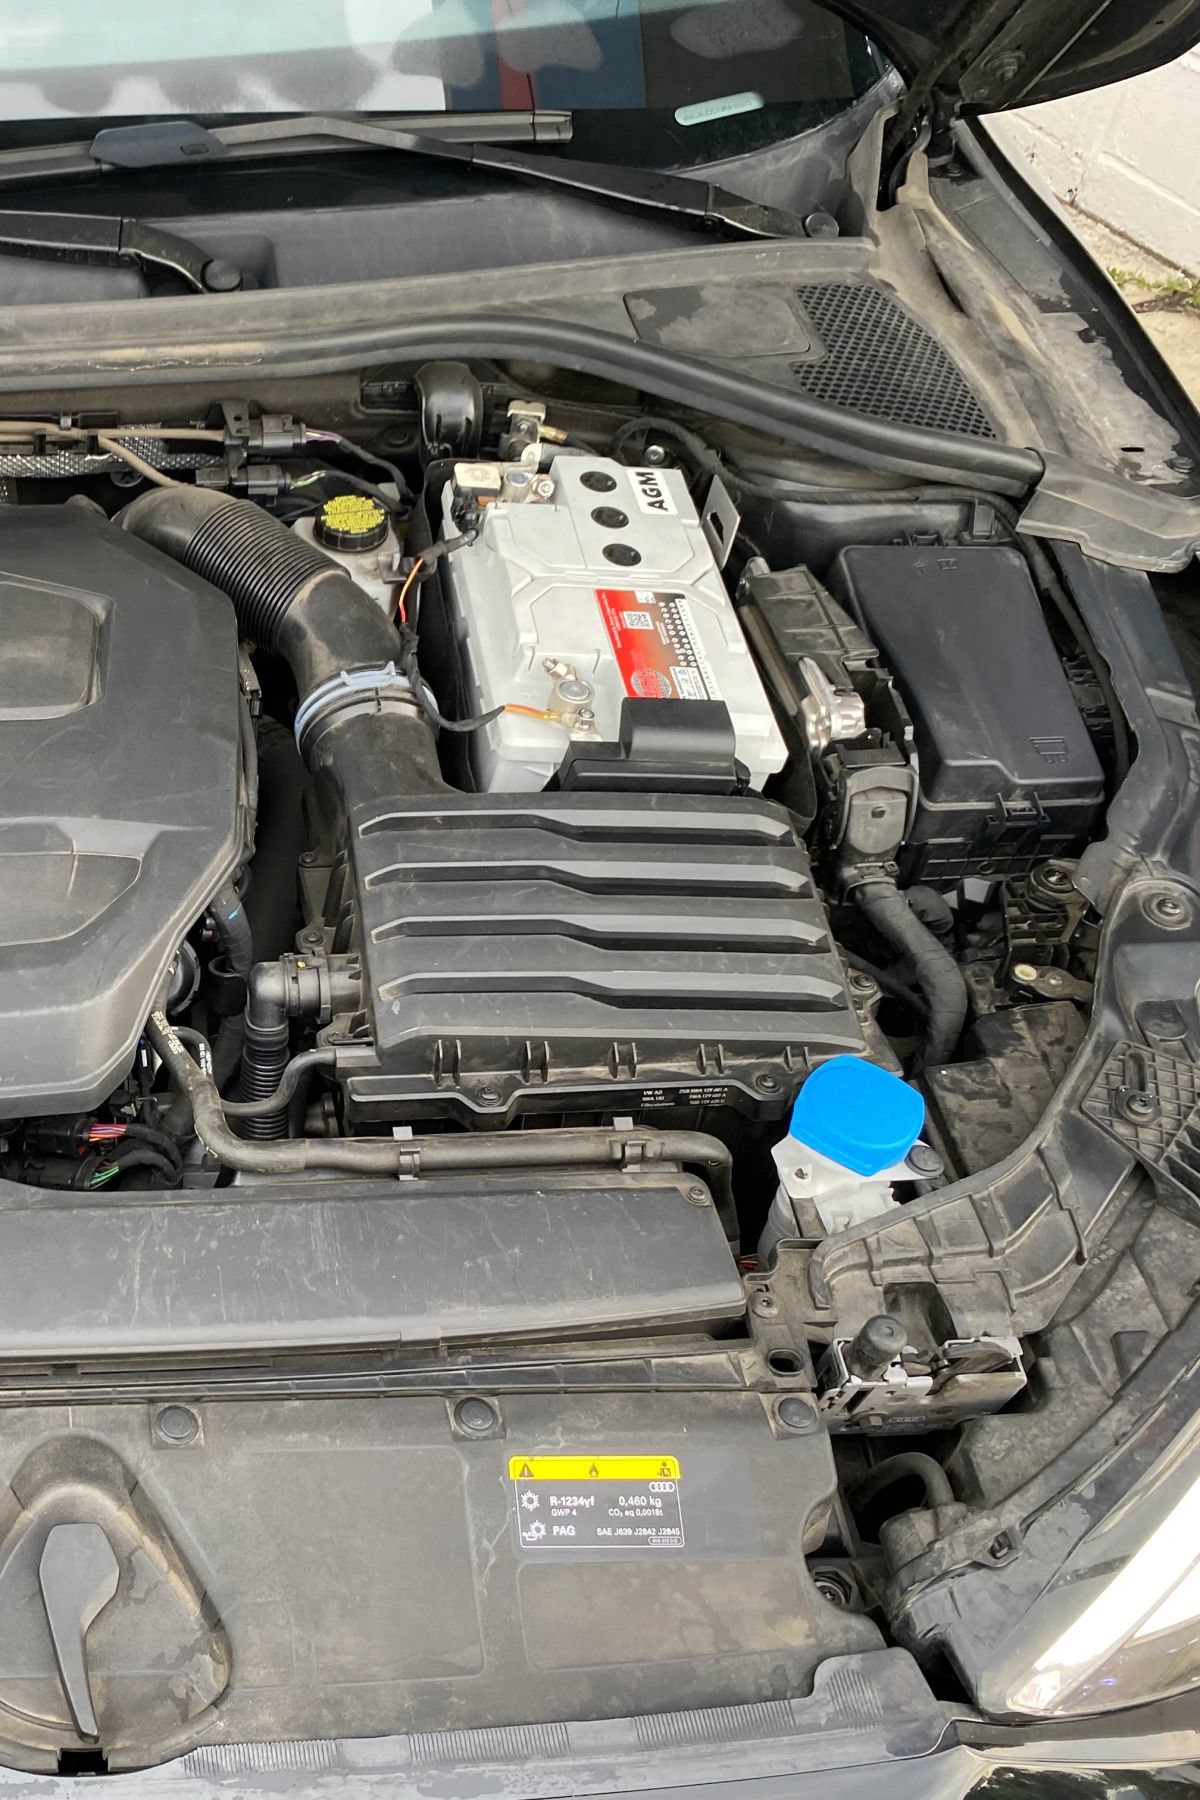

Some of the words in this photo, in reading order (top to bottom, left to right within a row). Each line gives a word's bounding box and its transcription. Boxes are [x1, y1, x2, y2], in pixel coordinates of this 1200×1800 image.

[635, 470, 669, 512] AGM
[550, 1496, 595, 1508] R-1234yf
[618, 1495, 647, 1507] 0,460
[649, 1495, 662, 1508] kg
[551, 1508, 571, 1516] GWP
[572, 1508, 577, 1516] 4
[624, 1509, 635, 1518] eq
[552, 1525, 576, 1536] PAG
[596, 1527, 613, 1536] SAE
[614, 1527, 632, 1536] J639
[634, 1527, 656, 1536] J2842
[658, 1527, 680, 1536] J2845
